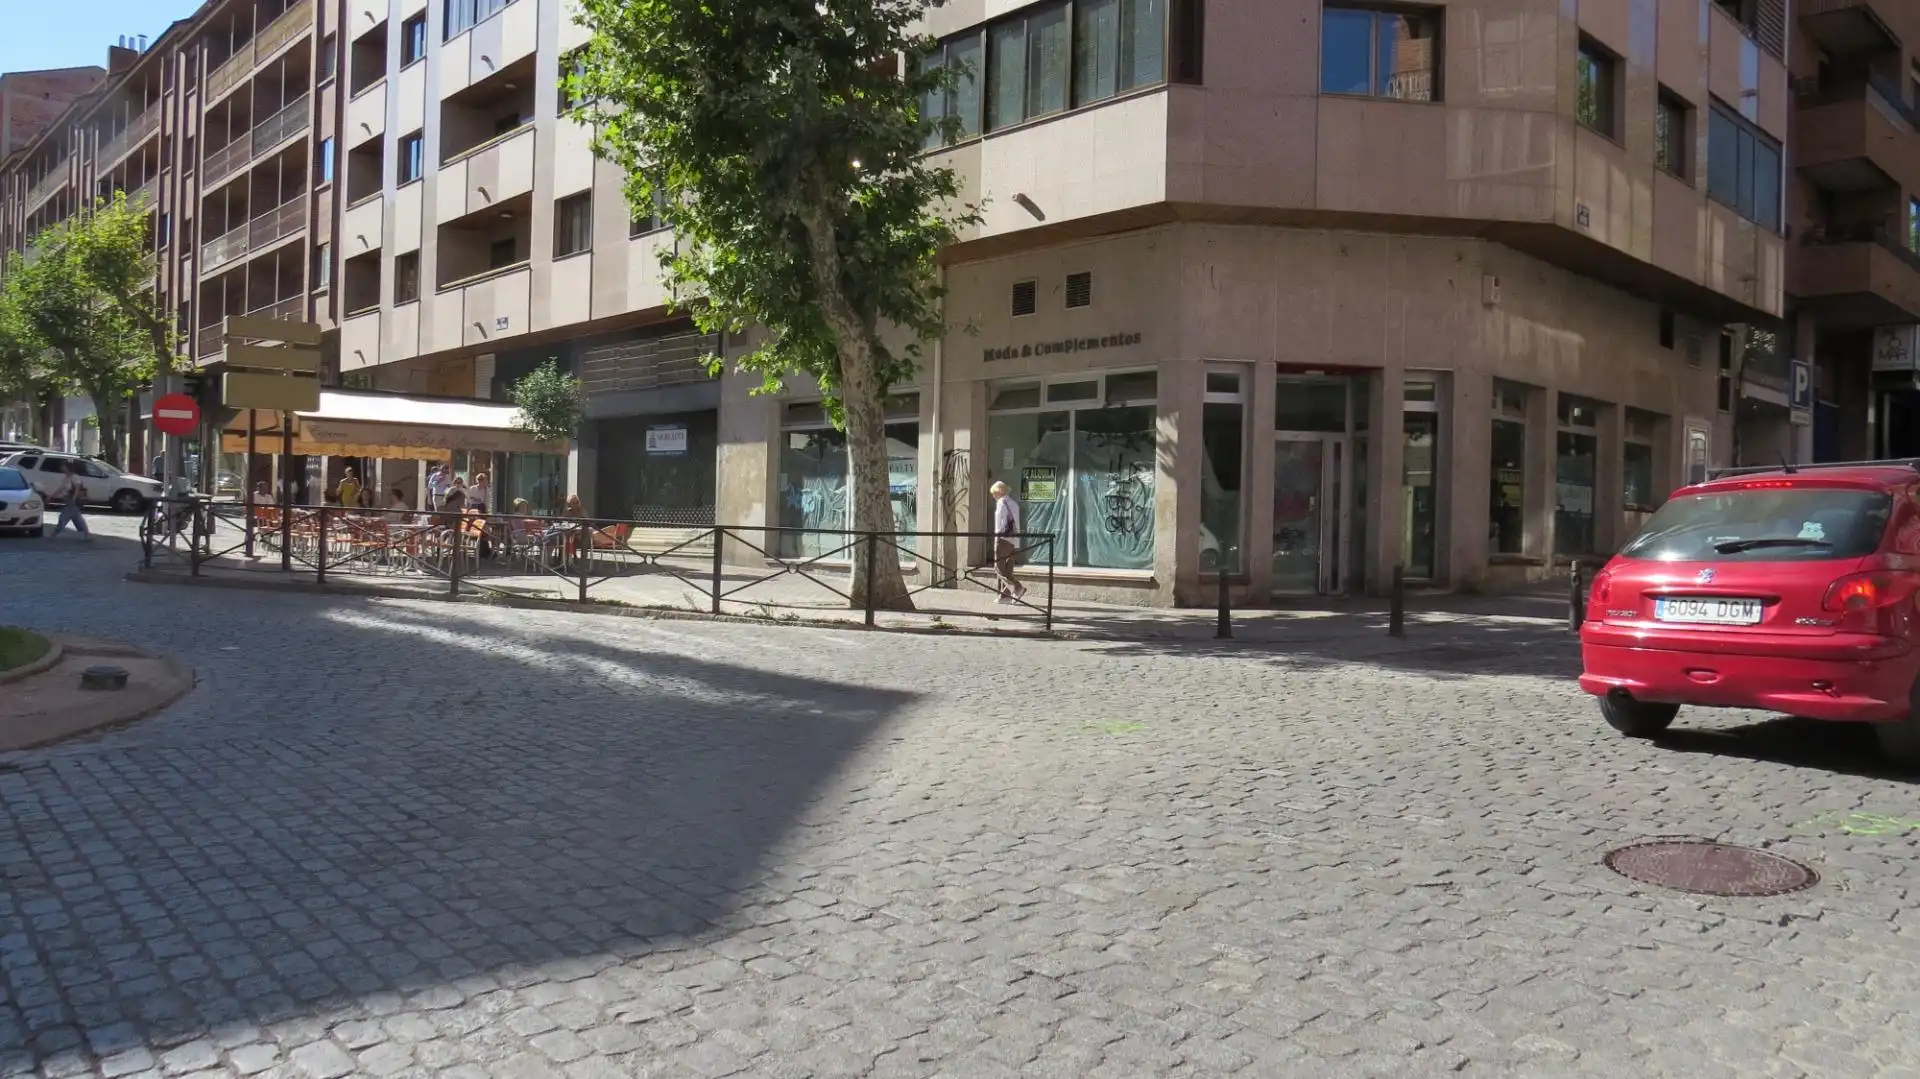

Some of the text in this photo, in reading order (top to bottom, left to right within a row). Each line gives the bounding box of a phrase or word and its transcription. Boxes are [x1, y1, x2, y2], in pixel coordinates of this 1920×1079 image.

[983, 332, 1142, 362] Moda & Complementos
[1795, 366, 1808, 402] P
[1667, 600, 1754, 618] 6094 DGM
